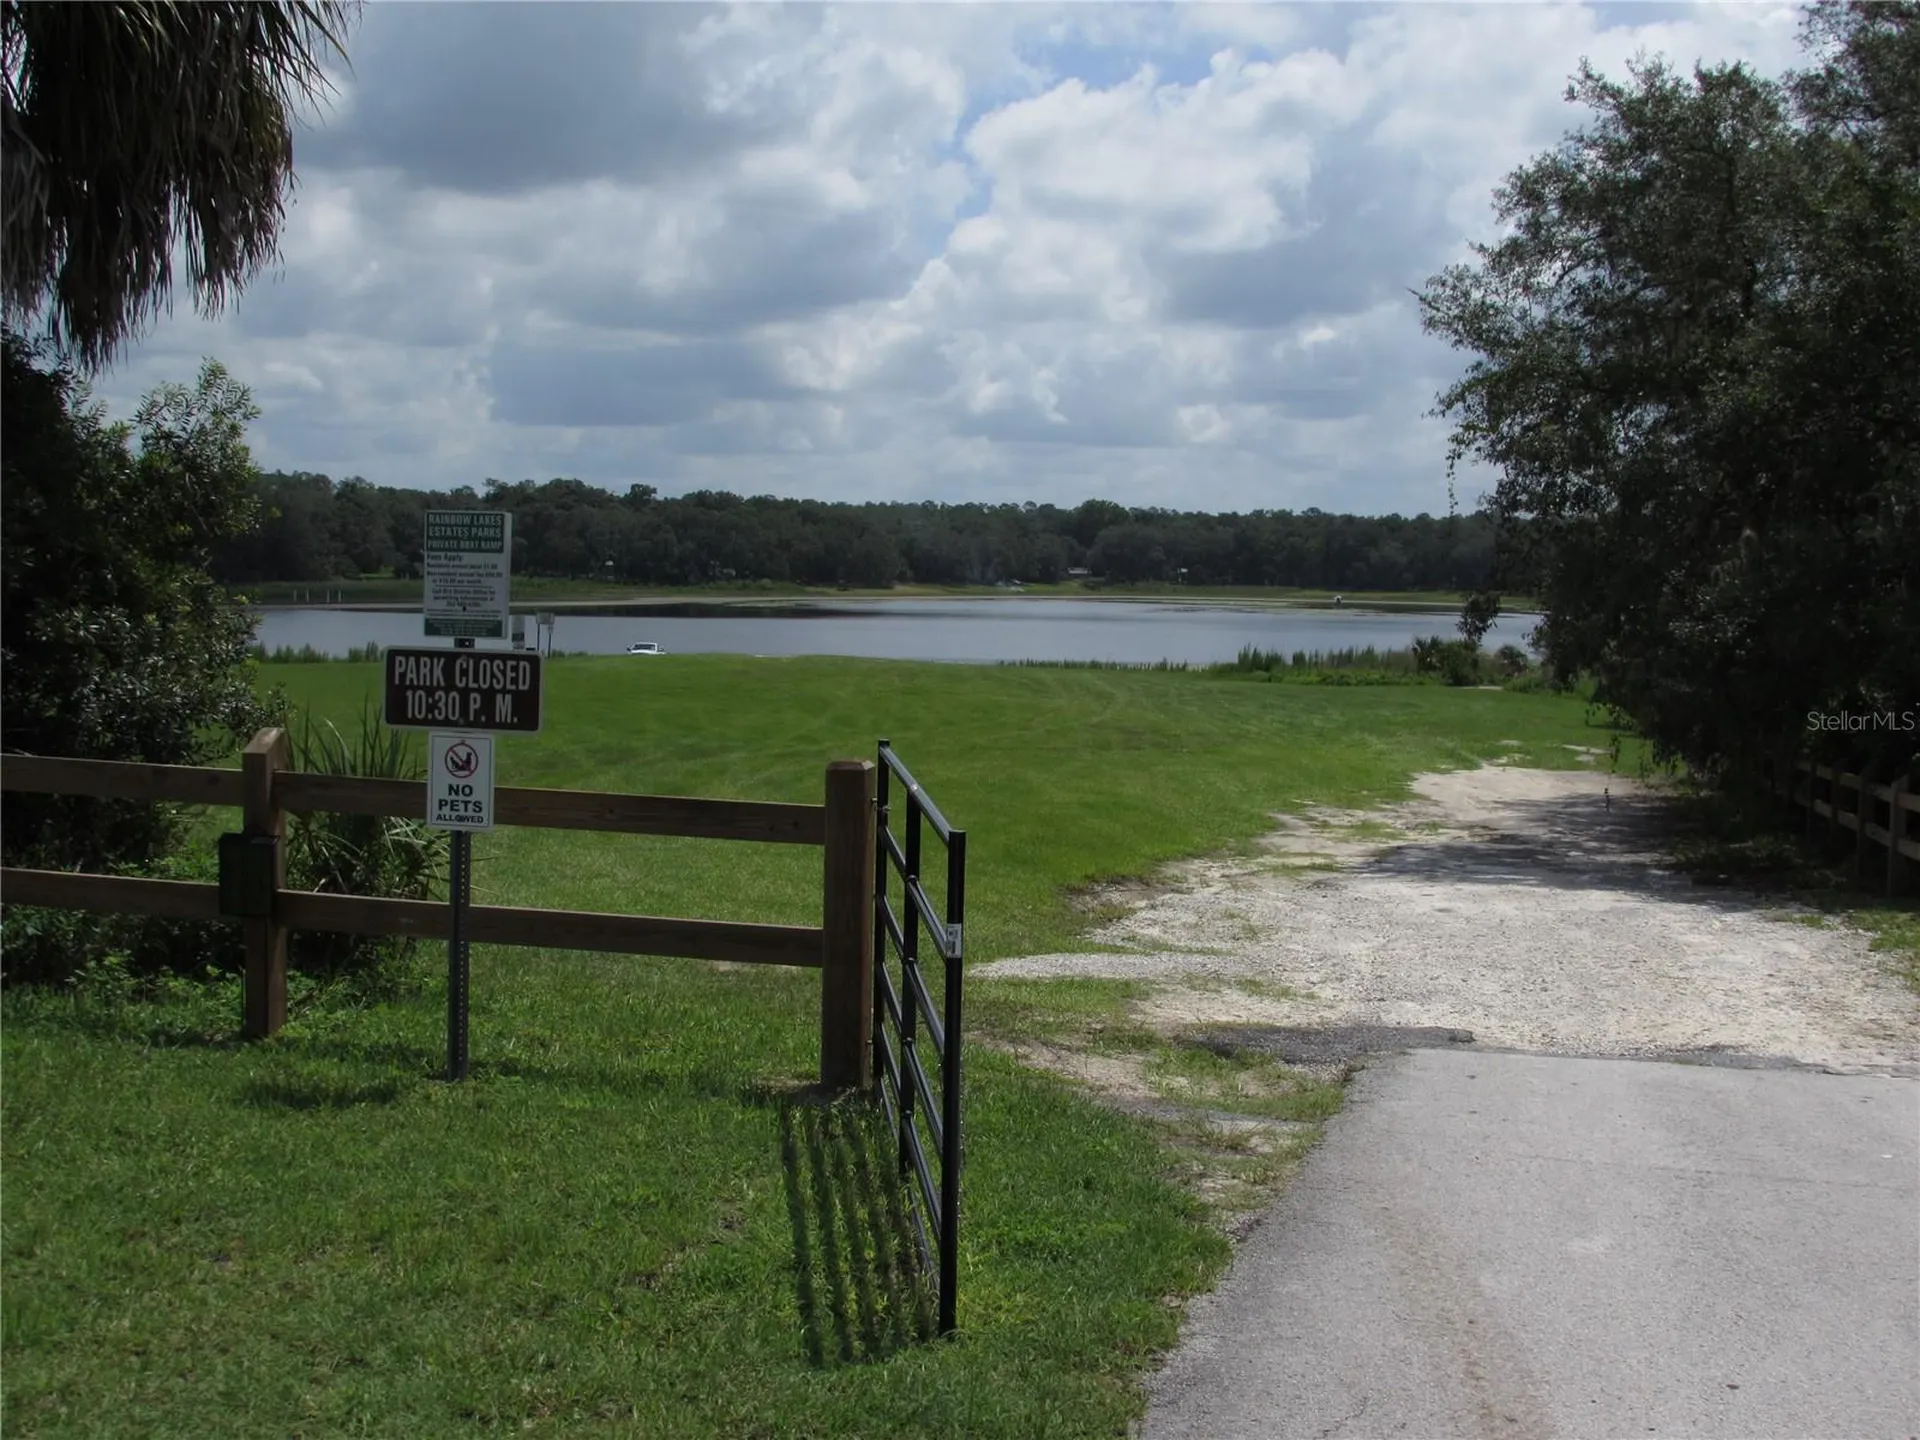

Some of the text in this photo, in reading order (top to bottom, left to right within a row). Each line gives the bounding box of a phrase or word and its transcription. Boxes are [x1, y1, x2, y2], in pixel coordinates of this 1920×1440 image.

[429, 514, 502, 528] RAINBOW LAKES
[428, 527, 502, 538] ESTATES PARKS
[394, 655, 531, 691] PARK CLOSED
[406, 689, 518, 724] 10:30 P. M.
[448, 783, 473, 797] NO
[438, 799, 483, 813] PETS
[435, 813, 484, 823] ALLOWED
